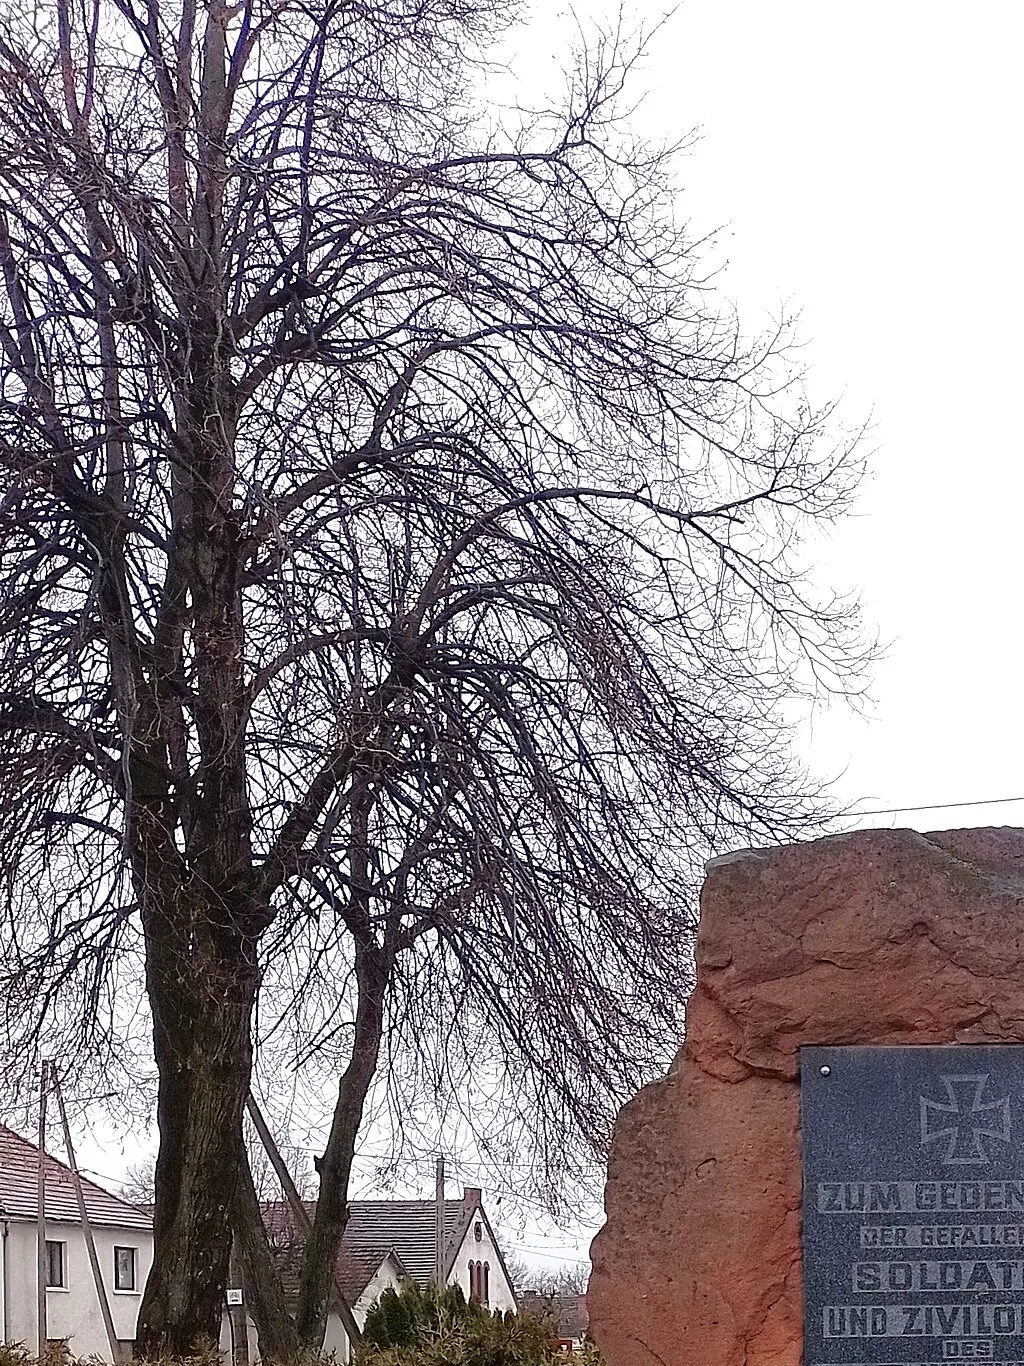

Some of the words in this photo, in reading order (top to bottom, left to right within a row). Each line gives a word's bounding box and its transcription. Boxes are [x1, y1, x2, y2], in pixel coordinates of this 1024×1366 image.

[822, 1183, 900, 1212] ZUM
[863, 1227, 907, 1247] DER
[828, 1307, 888, 1336] UND
[945, 1340, 992, 1358] DES
